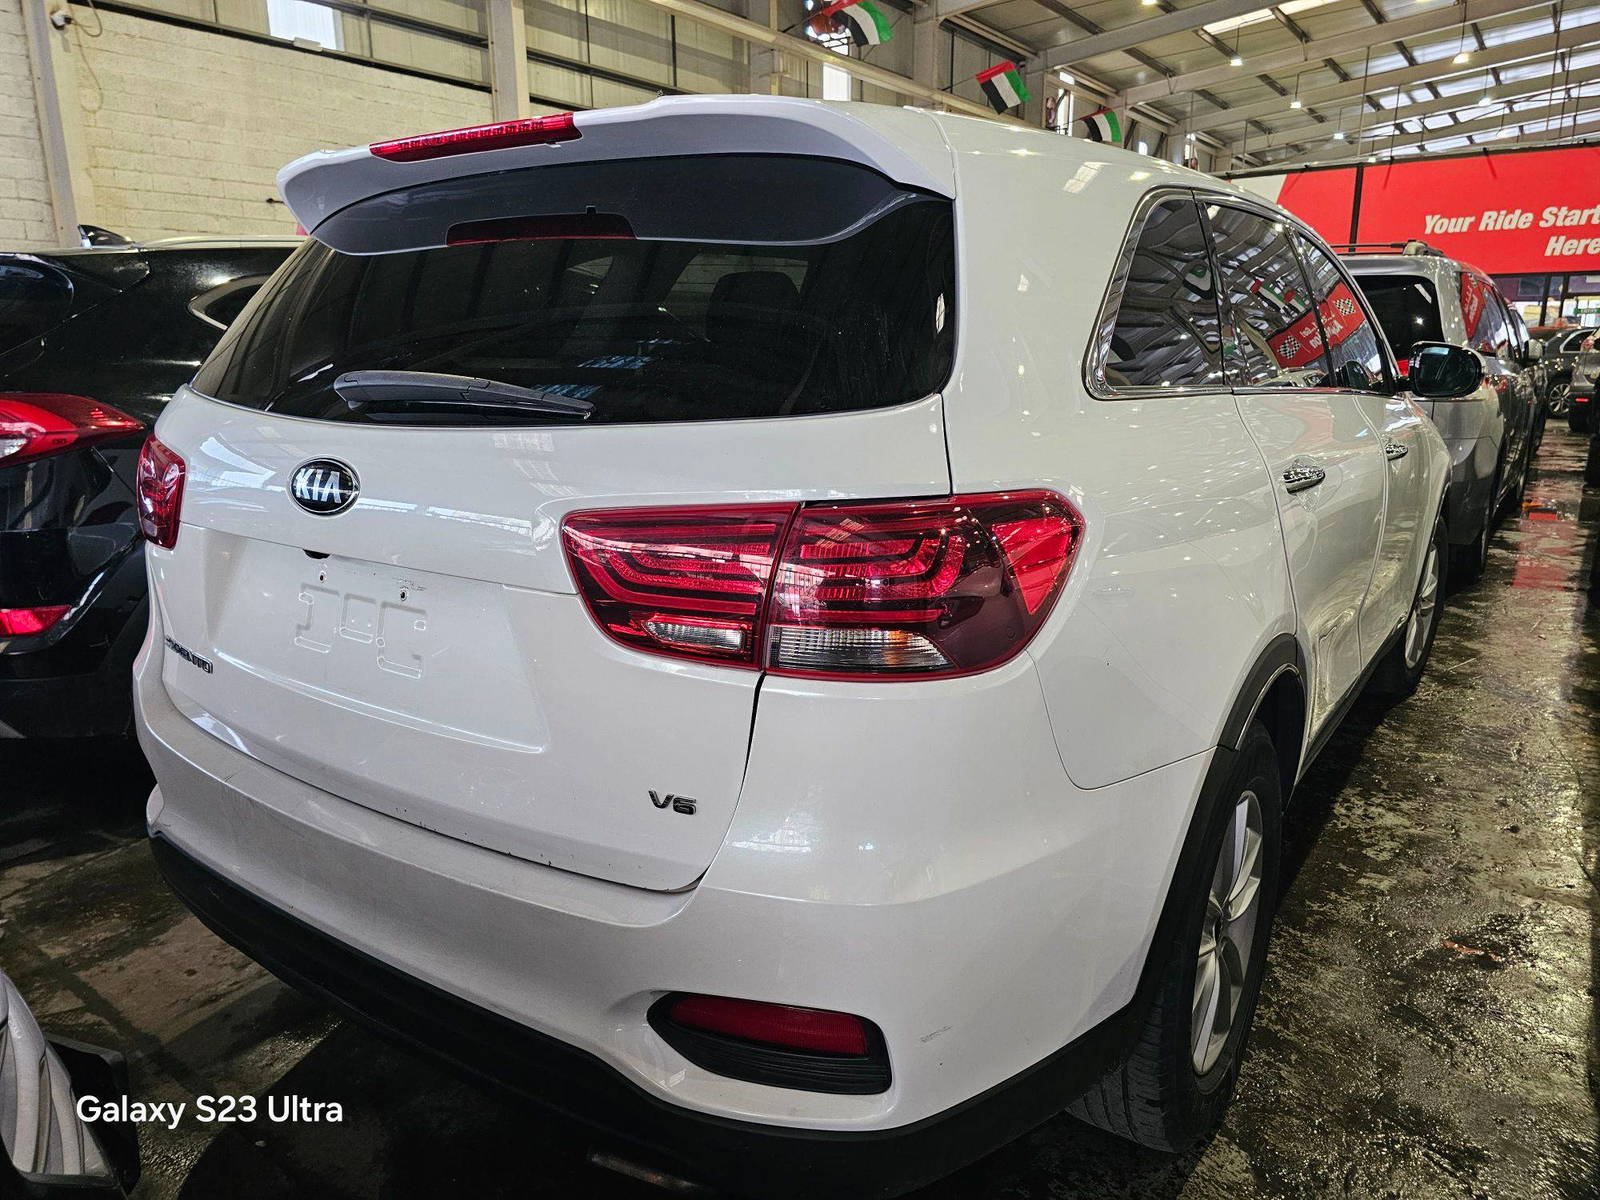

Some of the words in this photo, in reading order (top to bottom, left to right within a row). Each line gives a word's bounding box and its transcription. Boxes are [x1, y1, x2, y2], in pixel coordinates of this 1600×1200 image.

[1424, 213, 1476, 235] Your
[1478, 208, 1534, 231] Ride
[1544, 235, 1600, 257] Here
[295, 467, 342, 504] KIA
[648, 790, 697, 815] V6
